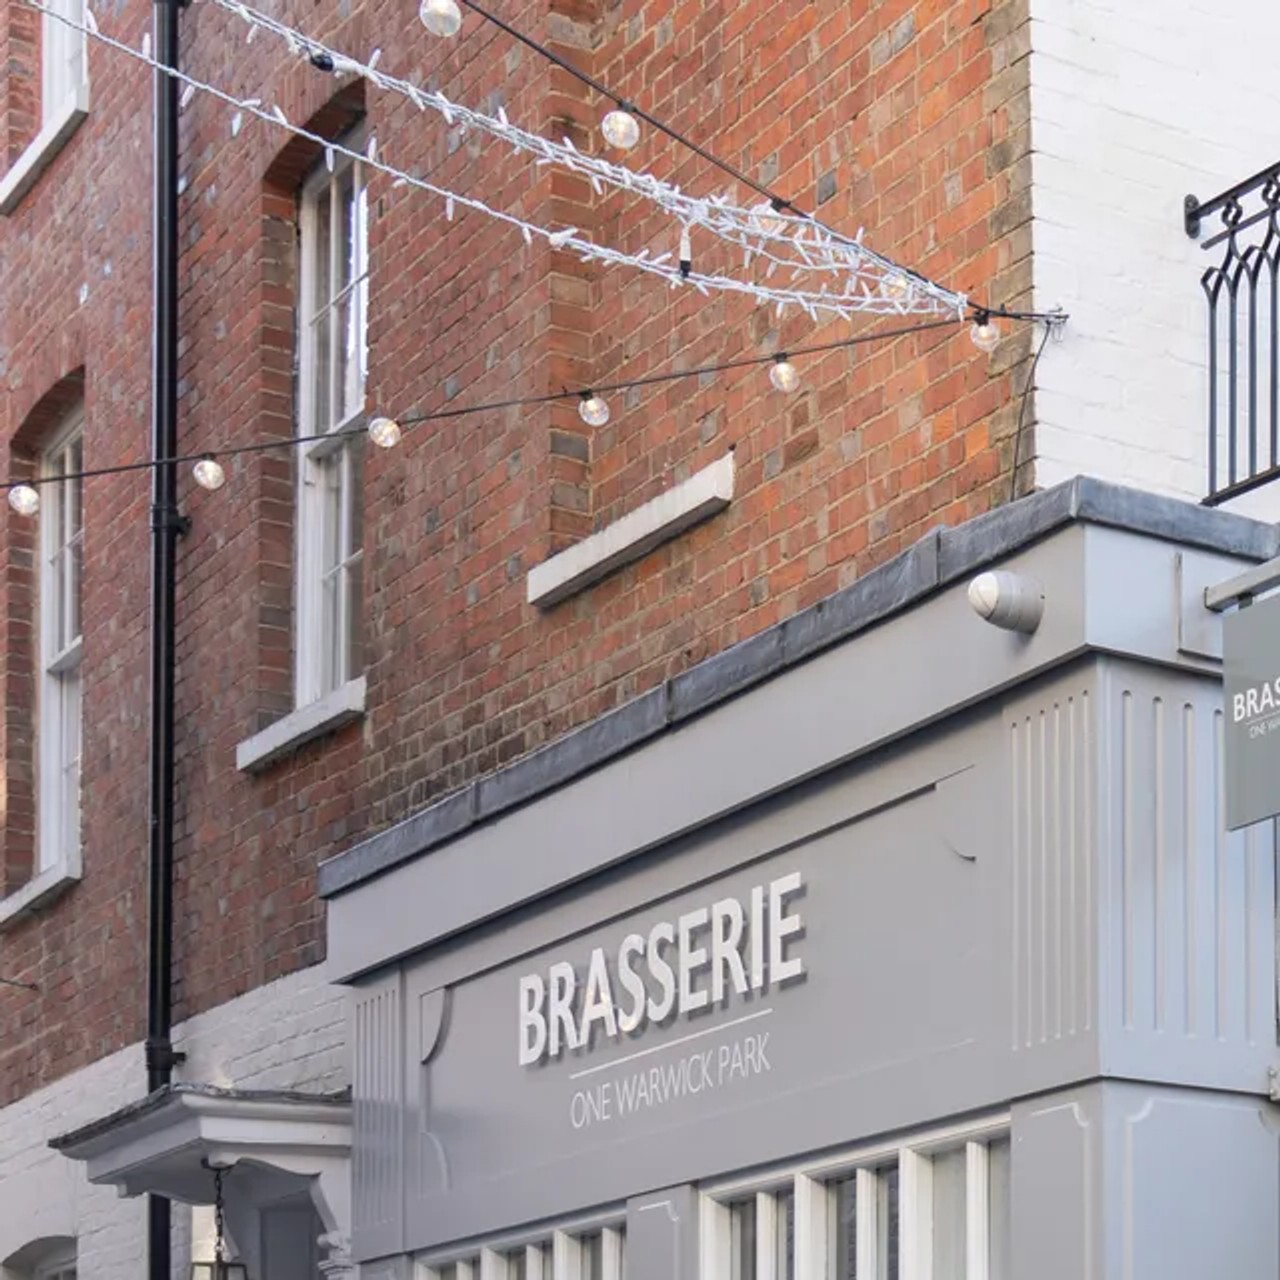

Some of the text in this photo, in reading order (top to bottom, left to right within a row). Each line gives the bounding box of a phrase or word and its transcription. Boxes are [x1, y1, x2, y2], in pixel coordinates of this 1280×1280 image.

[1249, 721, 1267, 739] ONE
[519, 871, 802, 1066] BRASSERIE
[569, 1031, 771, 1129] ONE WARWICK PARK
